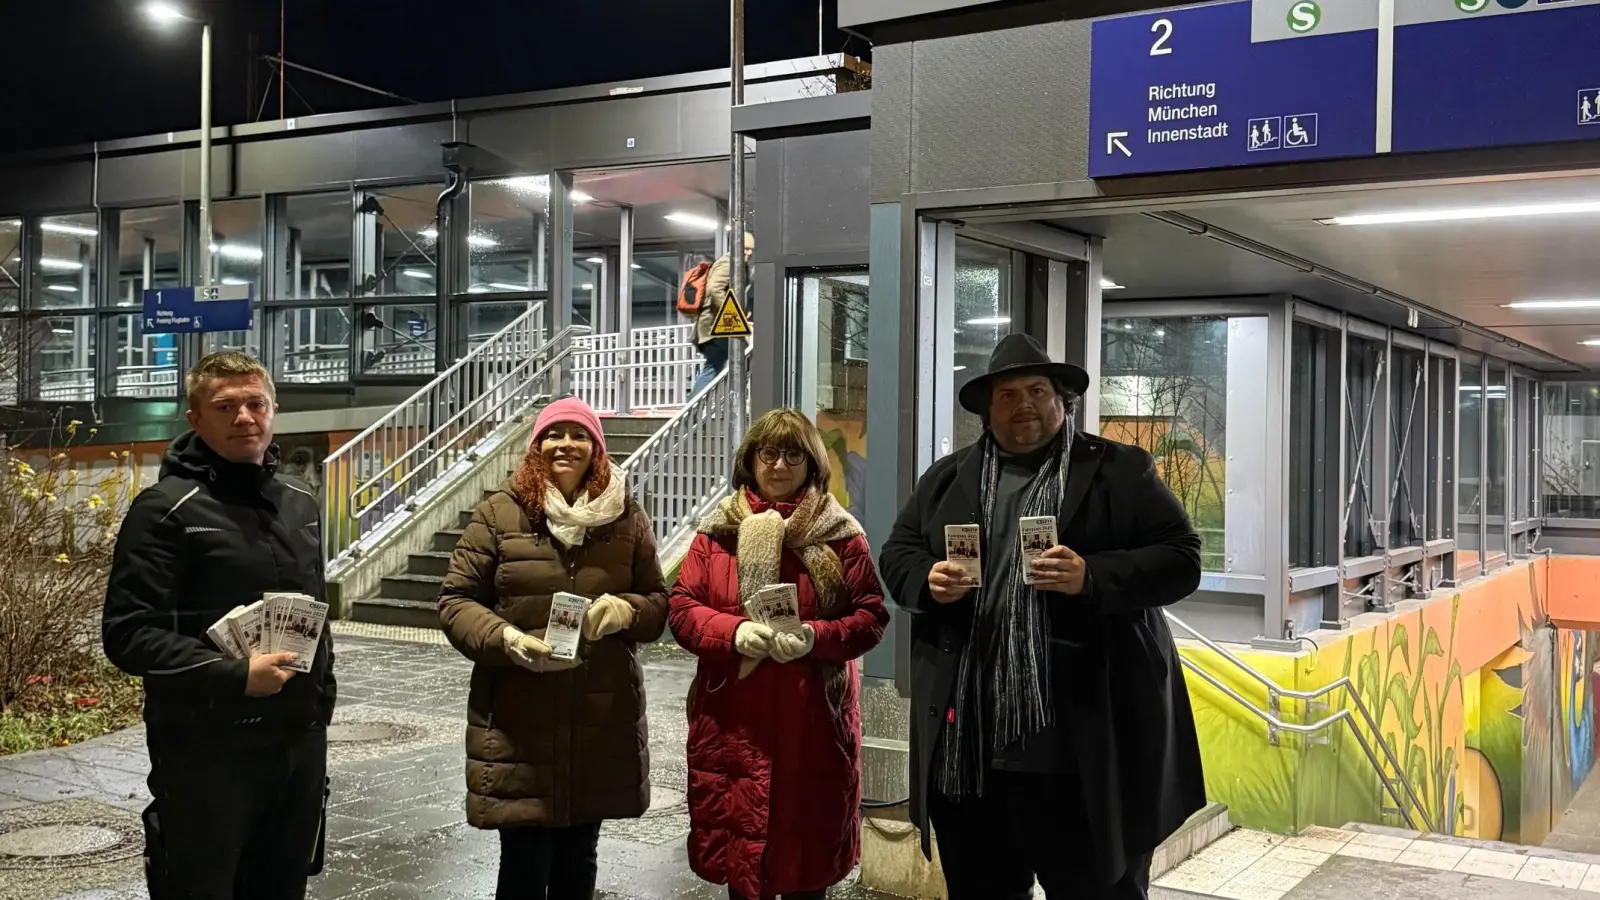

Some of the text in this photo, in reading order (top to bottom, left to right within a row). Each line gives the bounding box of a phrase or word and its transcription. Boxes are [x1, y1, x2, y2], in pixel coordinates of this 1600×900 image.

[1149, 19, 1173, 56] 2
[1148, 81, 1216, 102] Richtung
[1148, 102, 1218, 122] München
[1147, 122, 1229, 144] Innenstadt
[156, 291, 162, 304] 1
